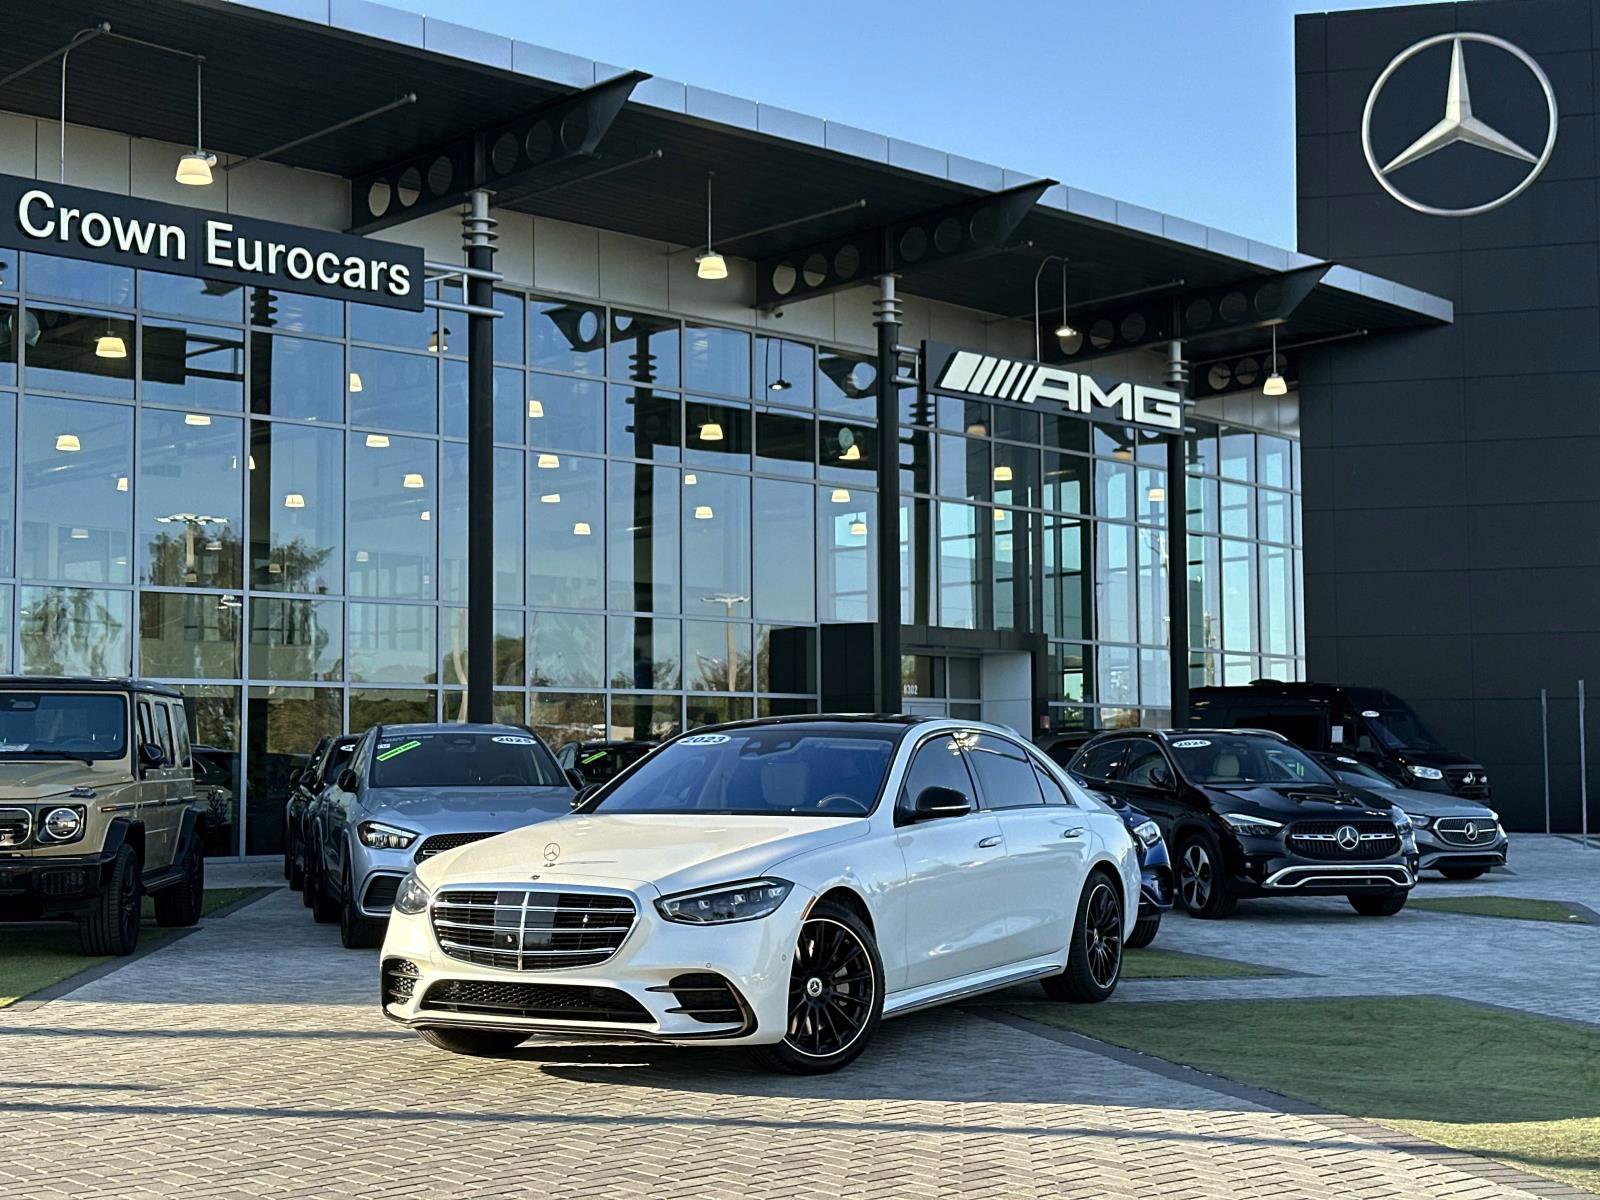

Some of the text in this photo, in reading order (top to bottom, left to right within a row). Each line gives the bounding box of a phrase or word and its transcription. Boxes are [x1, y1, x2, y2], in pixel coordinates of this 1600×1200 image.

[17, 189, 411, 296] Crown Eurocars
[1022, 366, 1181, 429] AMG
[496, 736, 532, 744] 2025
[680, 736, 726, 744] 2023
